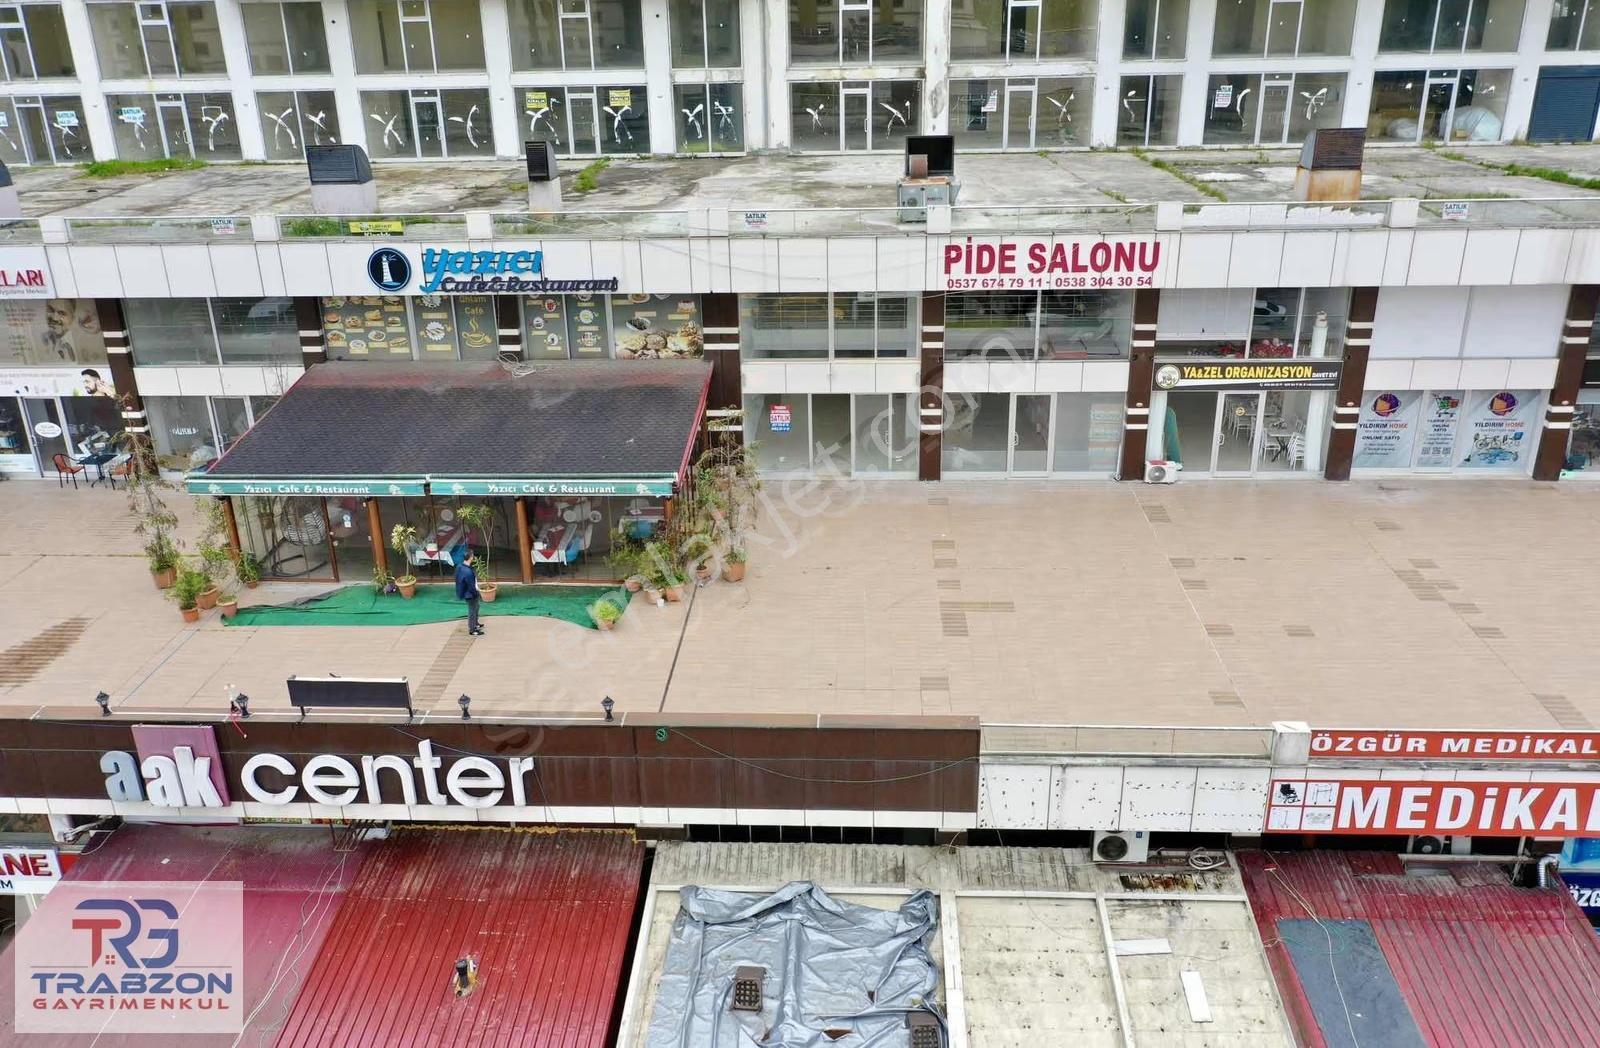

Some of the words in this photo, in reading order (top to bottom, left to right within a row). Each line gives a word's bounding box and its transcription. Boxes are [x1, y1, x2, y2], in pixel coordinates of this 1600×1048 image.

[944, 236, 1017, 274] PİDE
[1027, 241, 1161, 273] SALONU
[0, 270, 46, 287] LARI
[947, 279, 978, 288] 0537
[981, 278, 1004, 288] 674
[1009, 278, 1024, 287] 79
[1055, 277, 1086, 287] 0538
[1090, 277, 1113, 287] 304
[1117, 277, 1132, 286] 30
[1136, 276, 1152, 286] 54
[1183, 366, 1223, 378] YA&ZEL
[244, 485, 272, 493] Yazıcı
[278, 485, 300, 493] Cafe
[304, 485, 312, 493] &
[316, 485, 369, 494] Restaurant
[488, 485, 516, 493] Yazıcı
[522, 484, 545, 493] Cafe
[549, 485, 557, 493] &
[561, 485, 615, 493] Restaurant
[1312, 733, 1427, 752] ÖZGÜR
[1441, 735, 1598, 754] MEDİKAL
[100, 746, 223, 807] aak
[241, 738, 534, 808] center
[0, 854, 52, 876] NE
